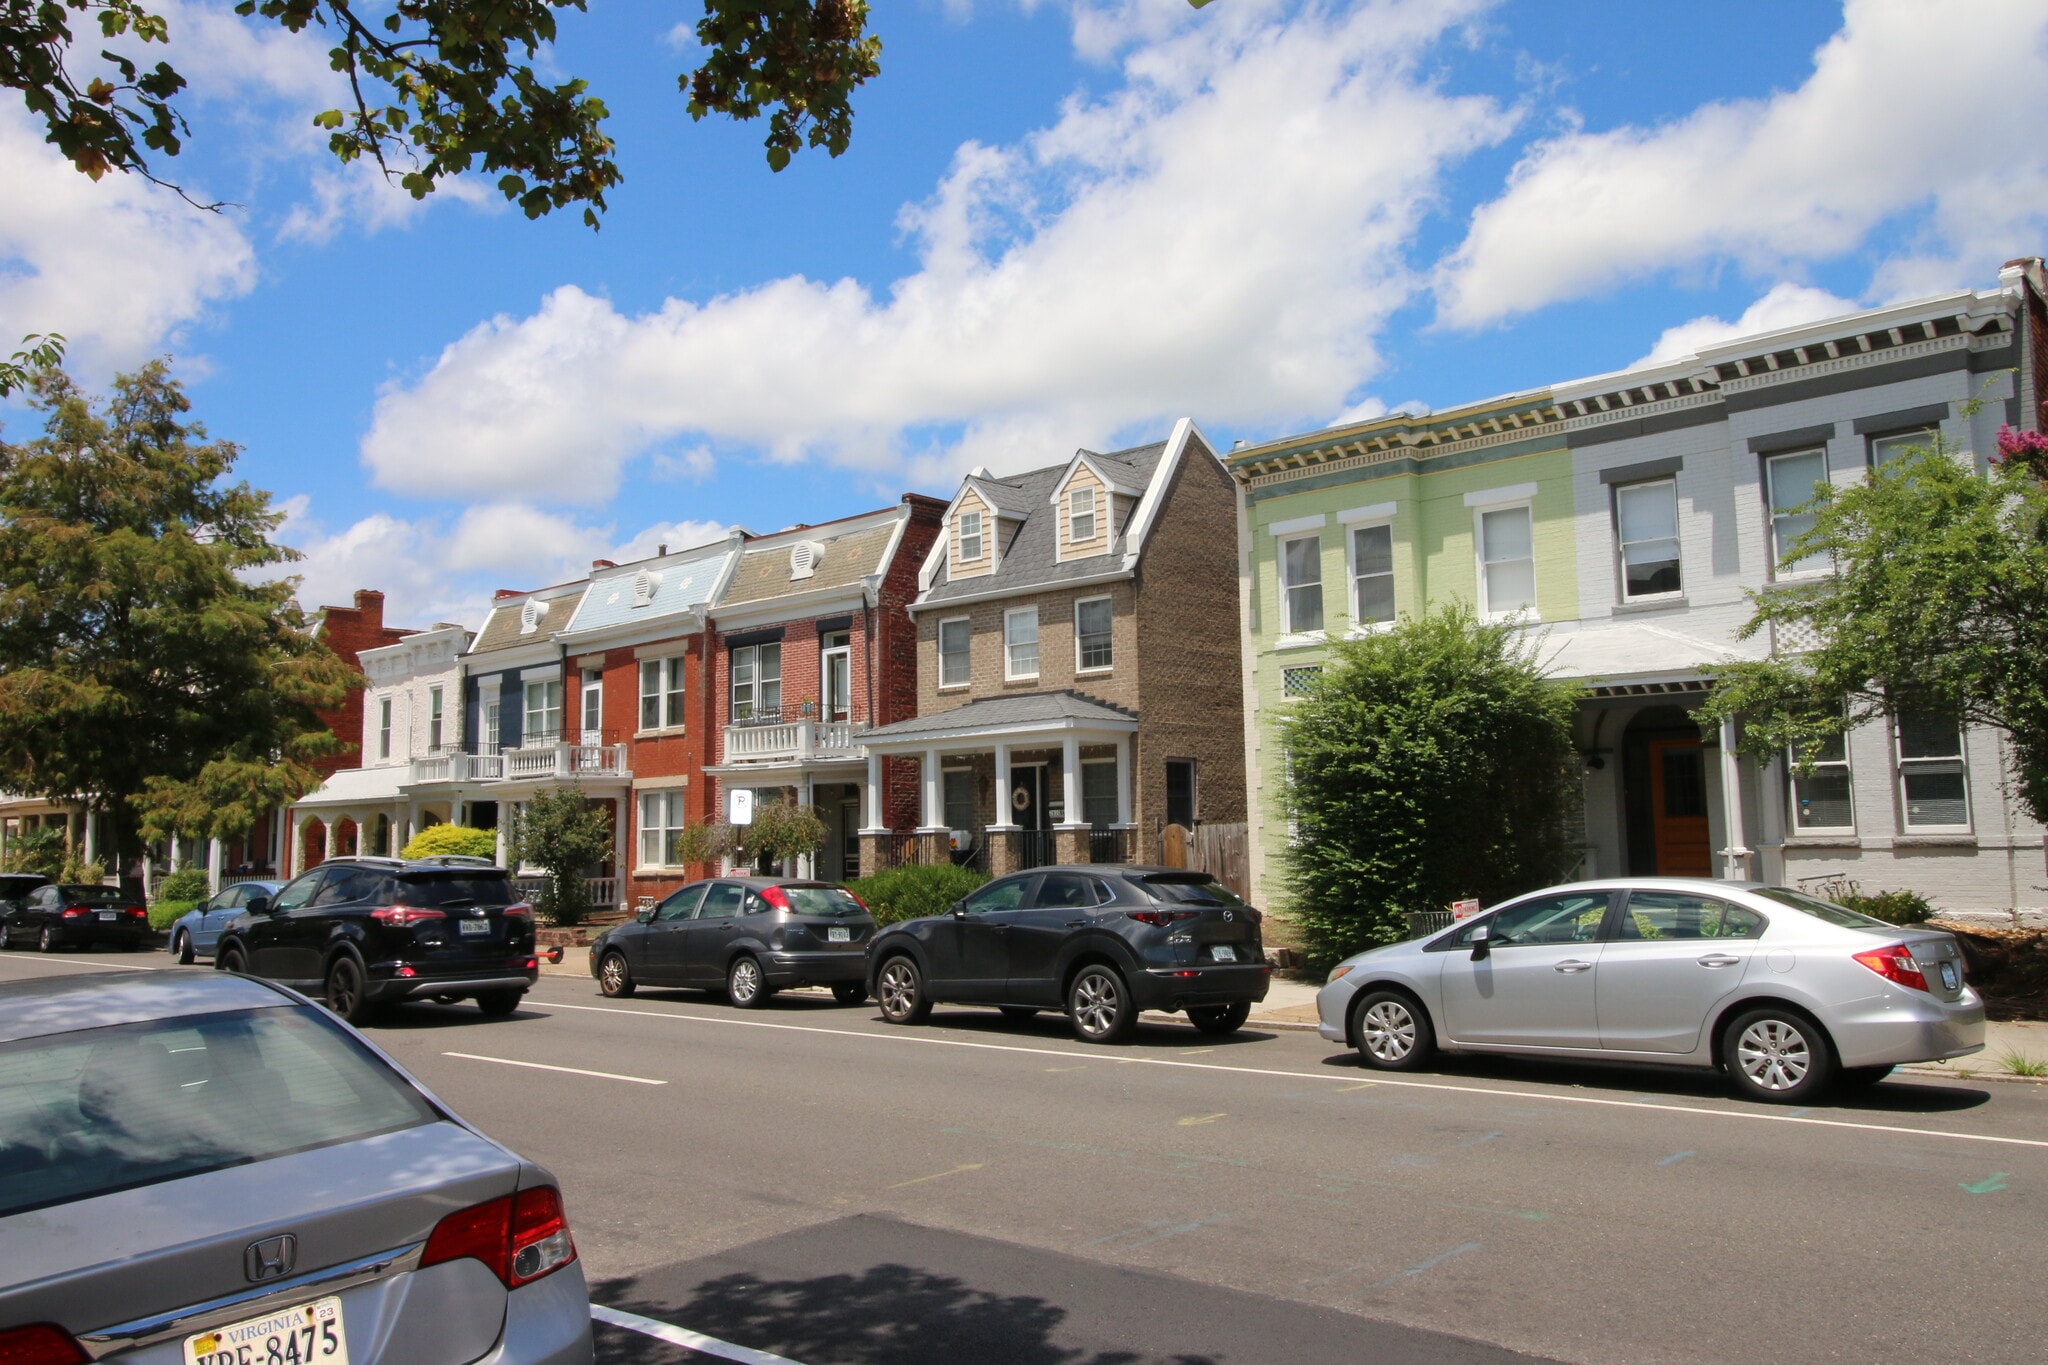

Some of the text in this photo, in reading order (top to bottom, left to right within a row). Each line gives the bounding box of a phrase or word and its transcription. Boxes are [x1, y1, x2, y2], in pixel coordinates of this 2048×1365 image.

[228, 1312, 304, 1344] VIRGINIA
[319, 1307, 334, 1318] 23
[197, 1317, 338, 1365] E-8475
